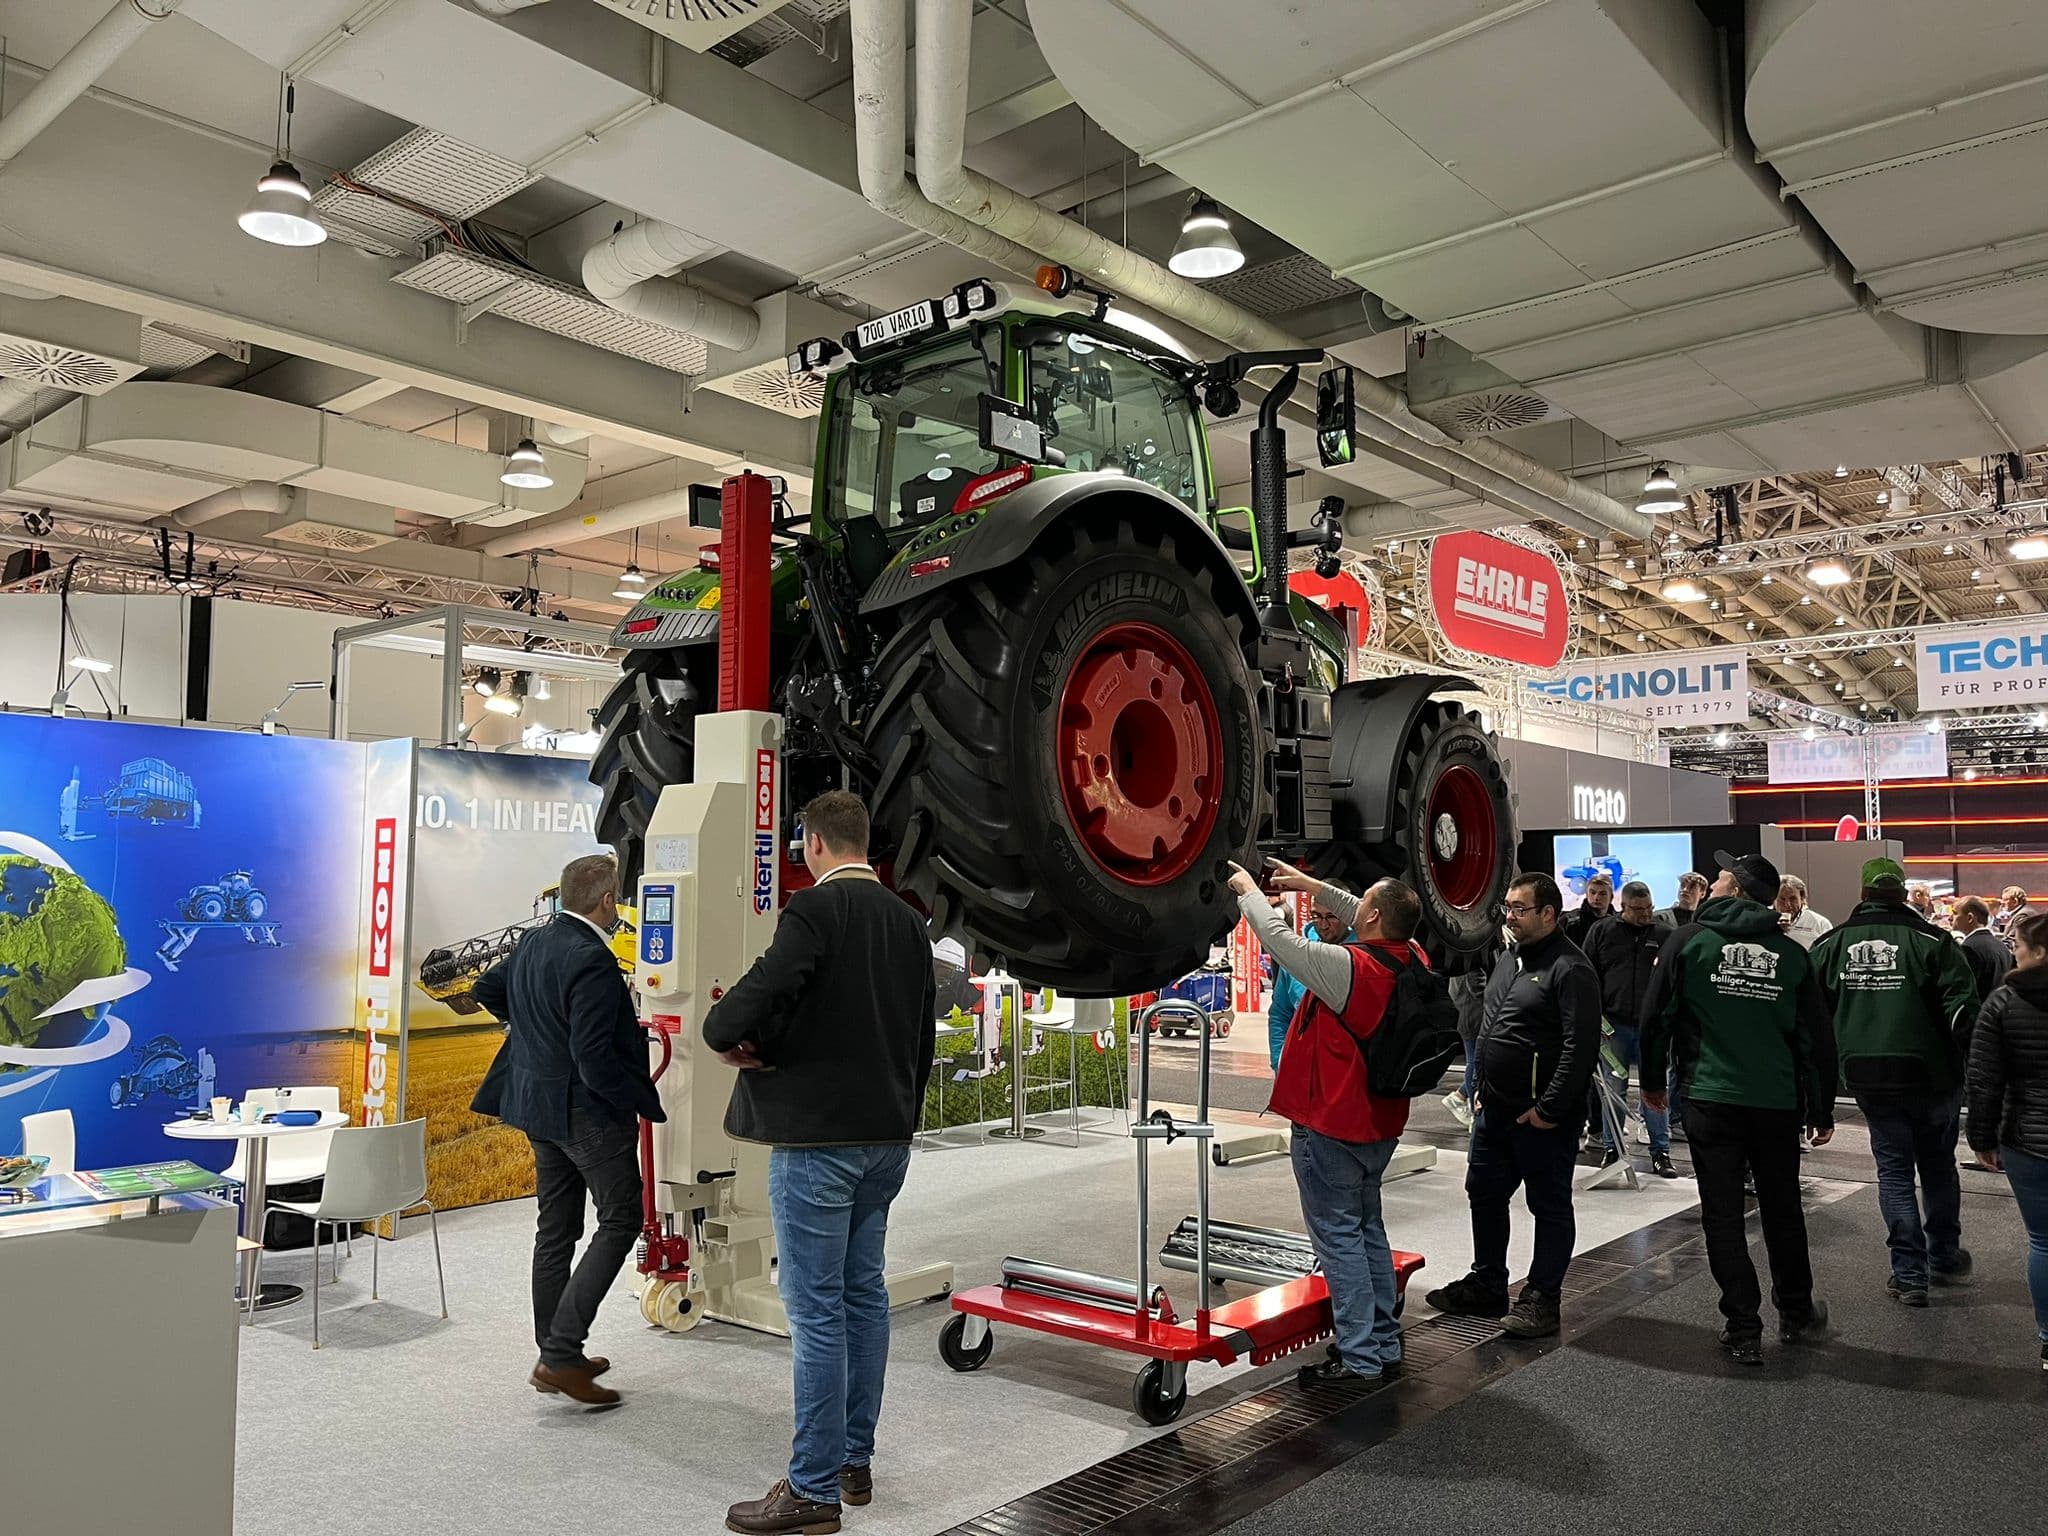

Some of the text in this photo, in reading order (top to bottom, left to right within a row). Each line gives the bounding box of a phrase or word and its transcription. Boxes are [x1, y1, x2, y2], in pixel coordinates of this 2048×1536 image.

[863, 321, 885, 344] 700
[889, 305, 927, 334] VARIO
[1457, 556, 1548, 619] EHRLE
[1054, 571, 1180, 655] MICHELIN
[1926, 634, 2048, 674] TECH
[1941, 682, 1980, 696] FÜR
[1646, 701, 1733, 717] SEIT 1979
[465, 798, 479, 831] 1
[494, 800, 522, 831] IN
[1573, 785, 1626, 825] mato
[754, 754, 773, 912] stertil KONI
[373, 827, 392, 968] KONI
[1710, 973, 1746, 986] Bolliger
[1839, 971, 1873, 982] Bolliger
